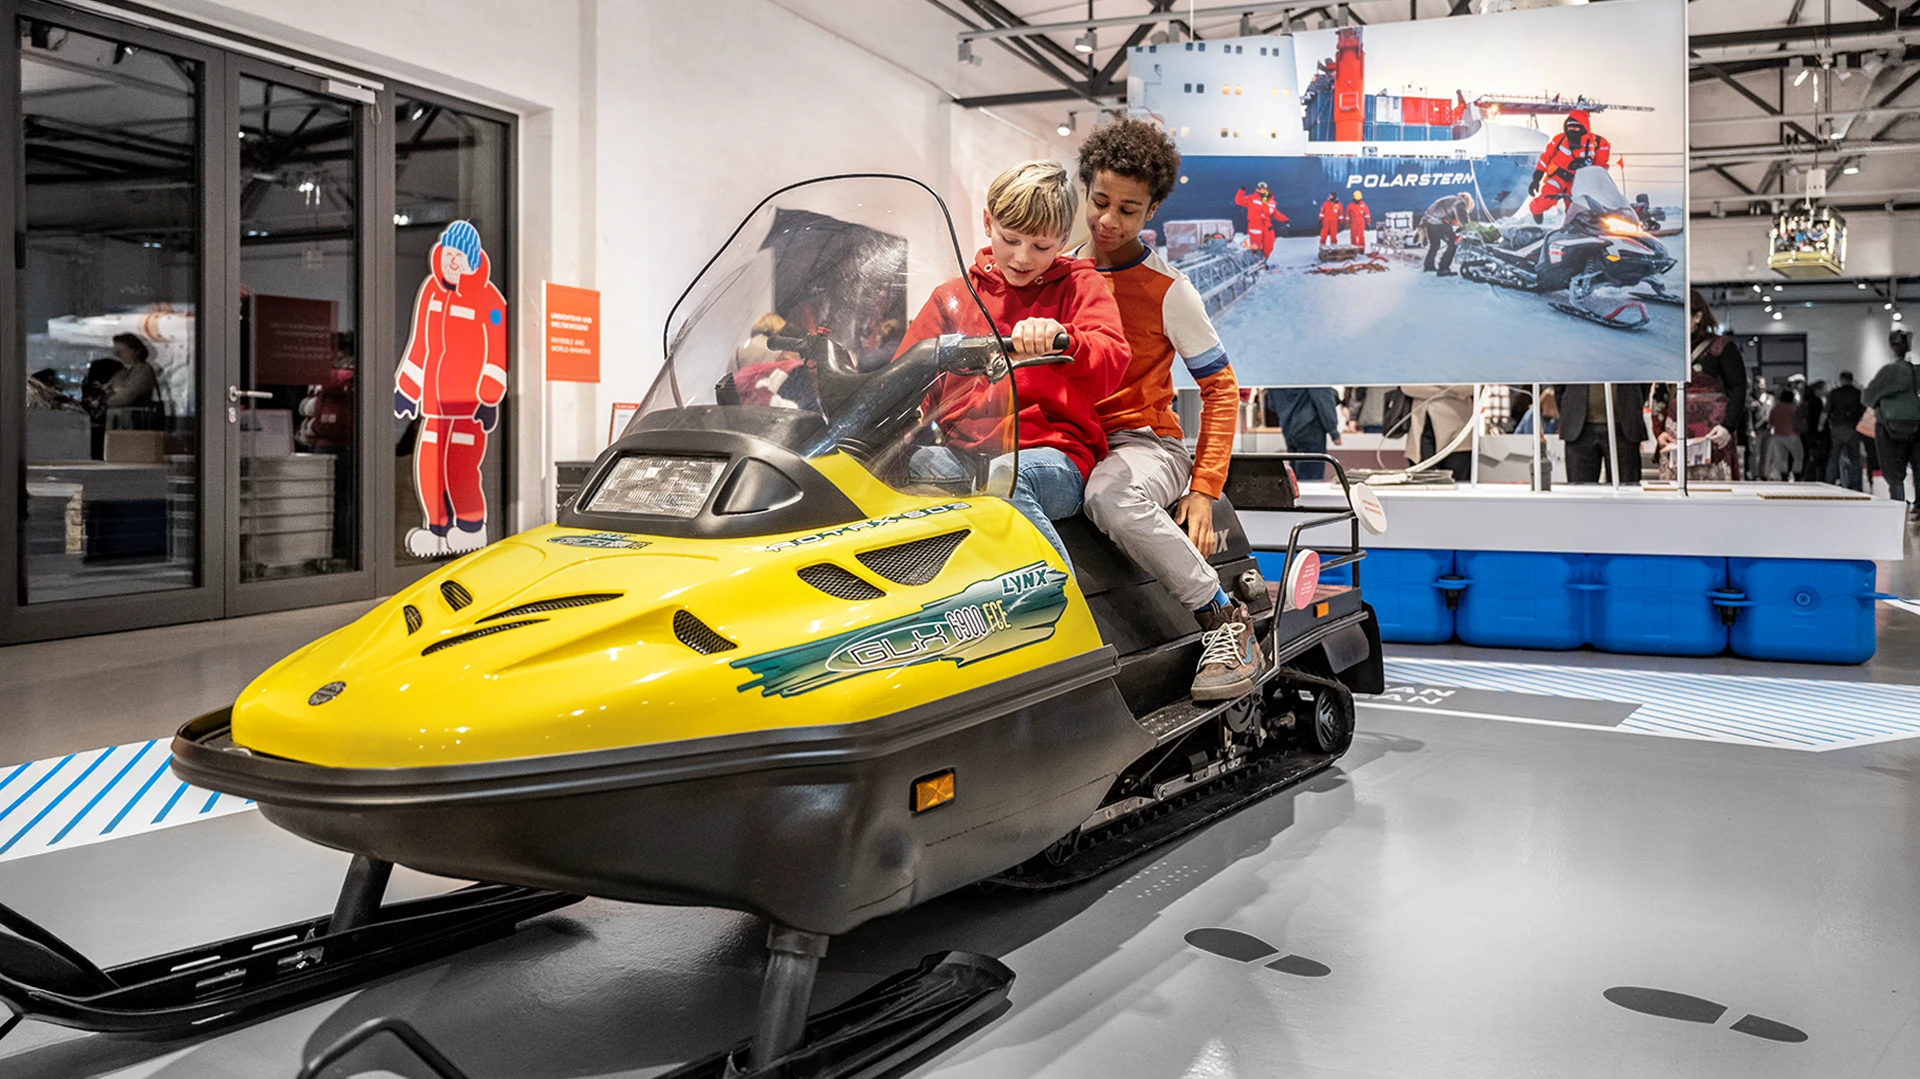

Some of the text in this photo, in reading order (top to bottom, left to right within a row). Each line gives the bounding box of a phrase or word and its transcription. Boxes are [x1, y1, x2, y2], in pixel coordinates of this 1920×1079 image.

[1346, 173, 1475, 189] POLARSTERN
[1001, 568, 1050, 596] LYNX
[847, 600, 1013, 667] GLX 6900 FCE
